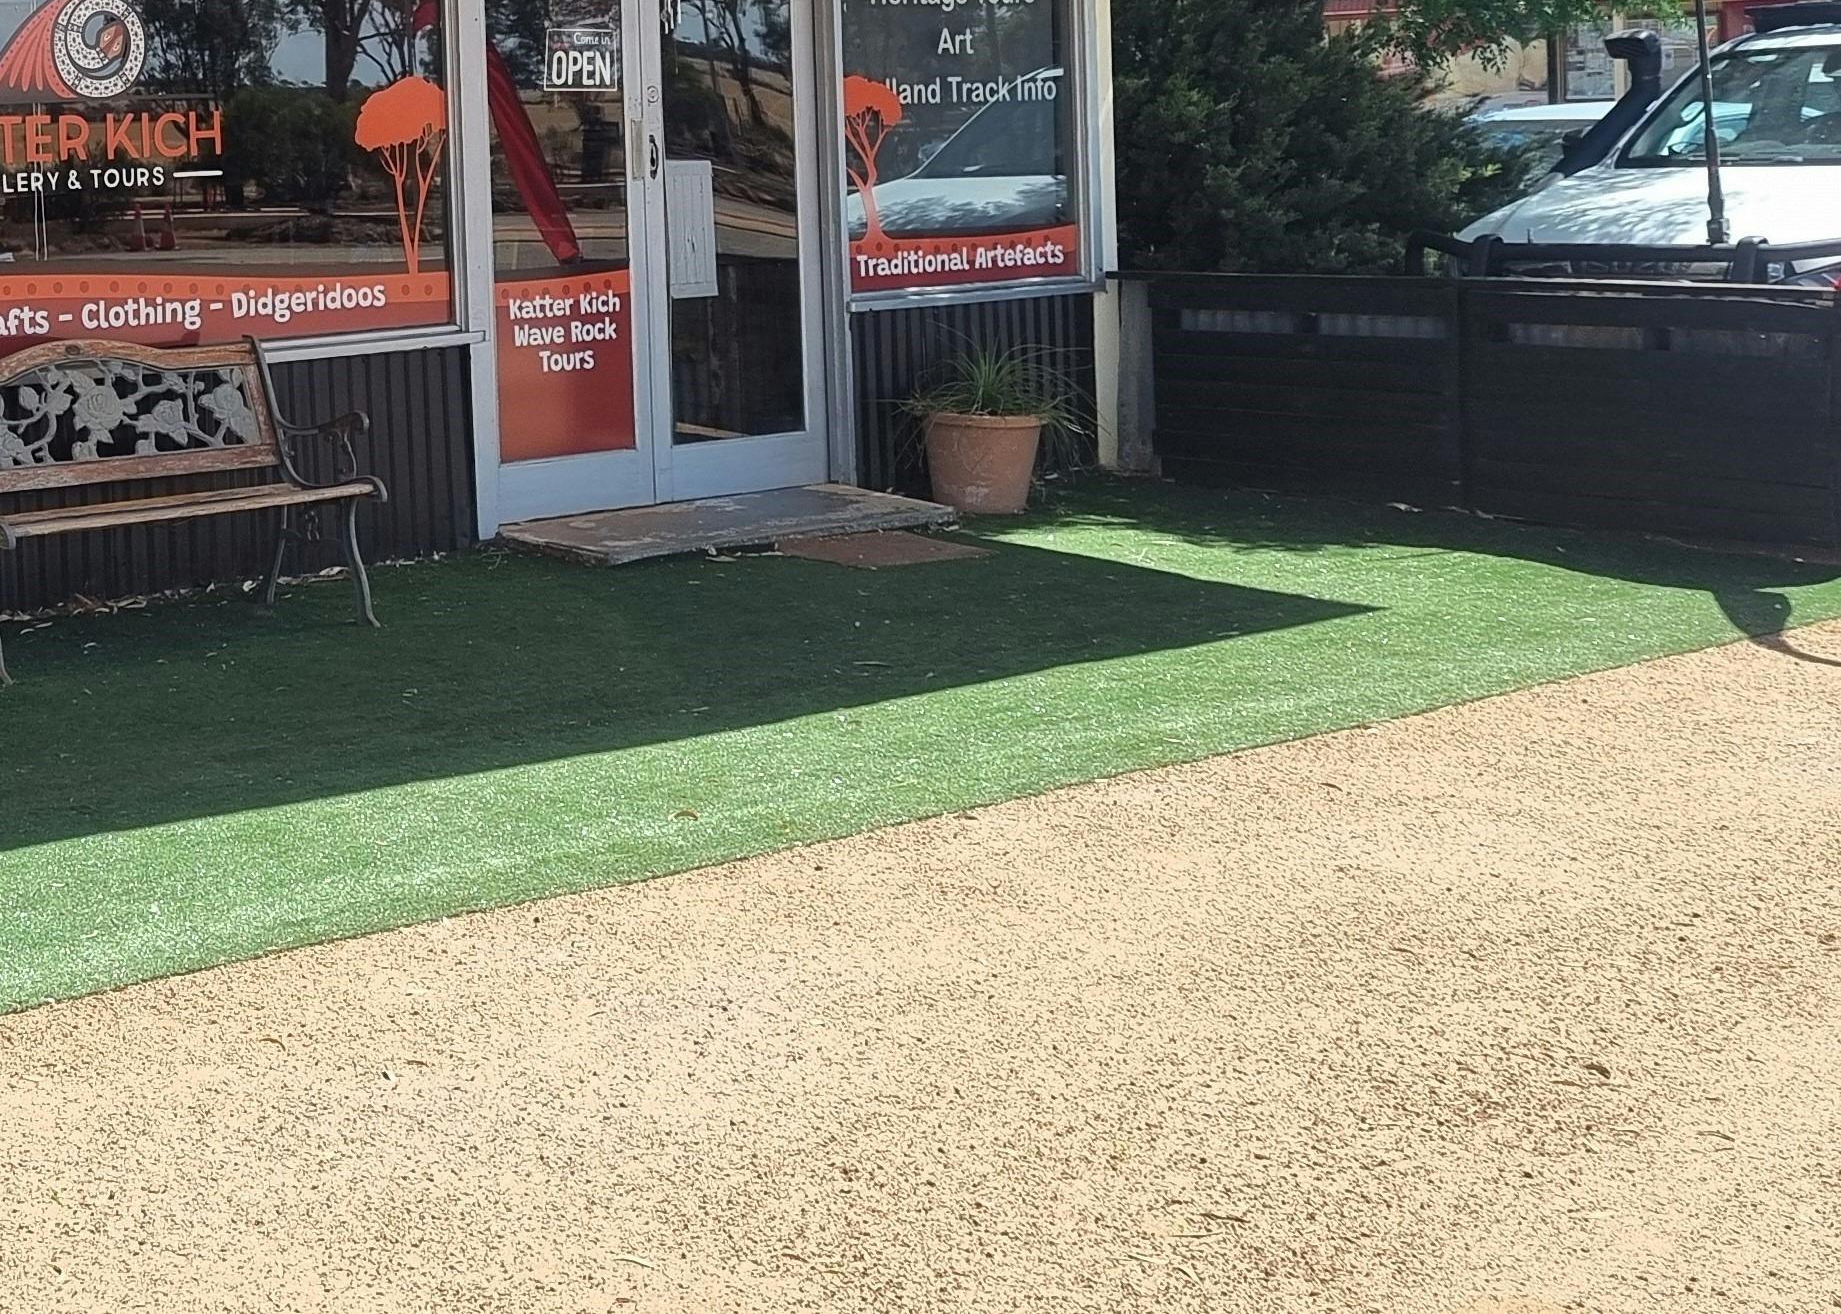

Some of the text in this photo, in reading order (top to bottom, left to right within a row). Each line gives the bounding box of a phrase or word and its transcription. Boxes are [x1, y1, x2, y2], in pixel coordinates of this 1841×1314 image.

[573, 32, 611, 45] Come in
[937, 27, 974, 55] Art
[552, 50, 610, 86] OPEN
[947, 75, 1010, 103] Track
[1017, 75, 1057, 101] Info
[106, 110, 224, 160] KICH
[67, 170, 82, 190] &
[90, 167, 165, 189] TOURS
[856, 240, 1064, 278] Traditional Artefacts
[81, 297, 202, 331] Clothing
[231, 283, 386, 324] Didgeridoos
[508, 291, 621, 321] Katter Kich
[513, 317, 617, 347] Wave Rock
[538, 348, 595, 373] Tours
